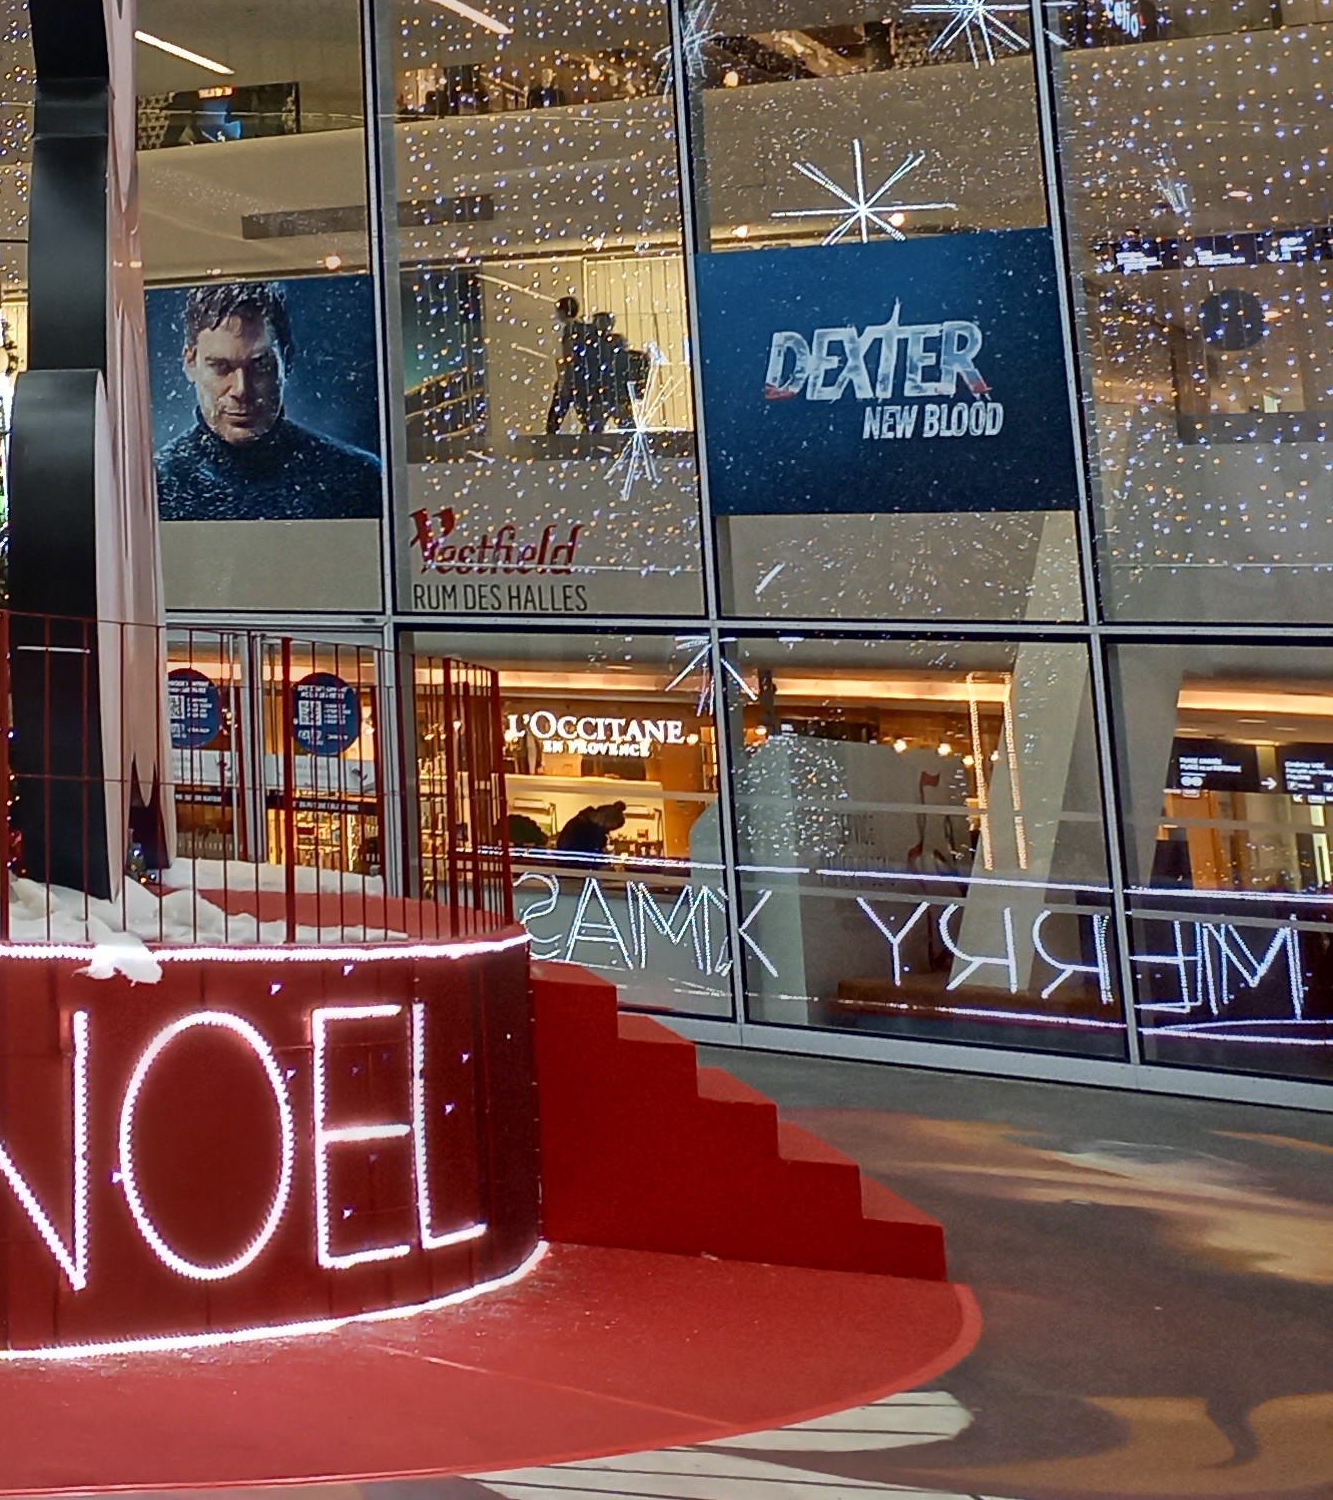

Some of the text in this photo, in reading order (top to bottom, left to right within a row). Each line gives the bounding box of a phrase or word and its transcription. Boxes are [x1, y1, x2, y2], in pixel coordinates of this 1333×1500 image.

[764, 298, 993, 401] DEXTER
[862, 400, 1004, 440] NEW BLOOD
[464, 584, 502, 611] DES
[507, 584, 588, 612] HALLES
